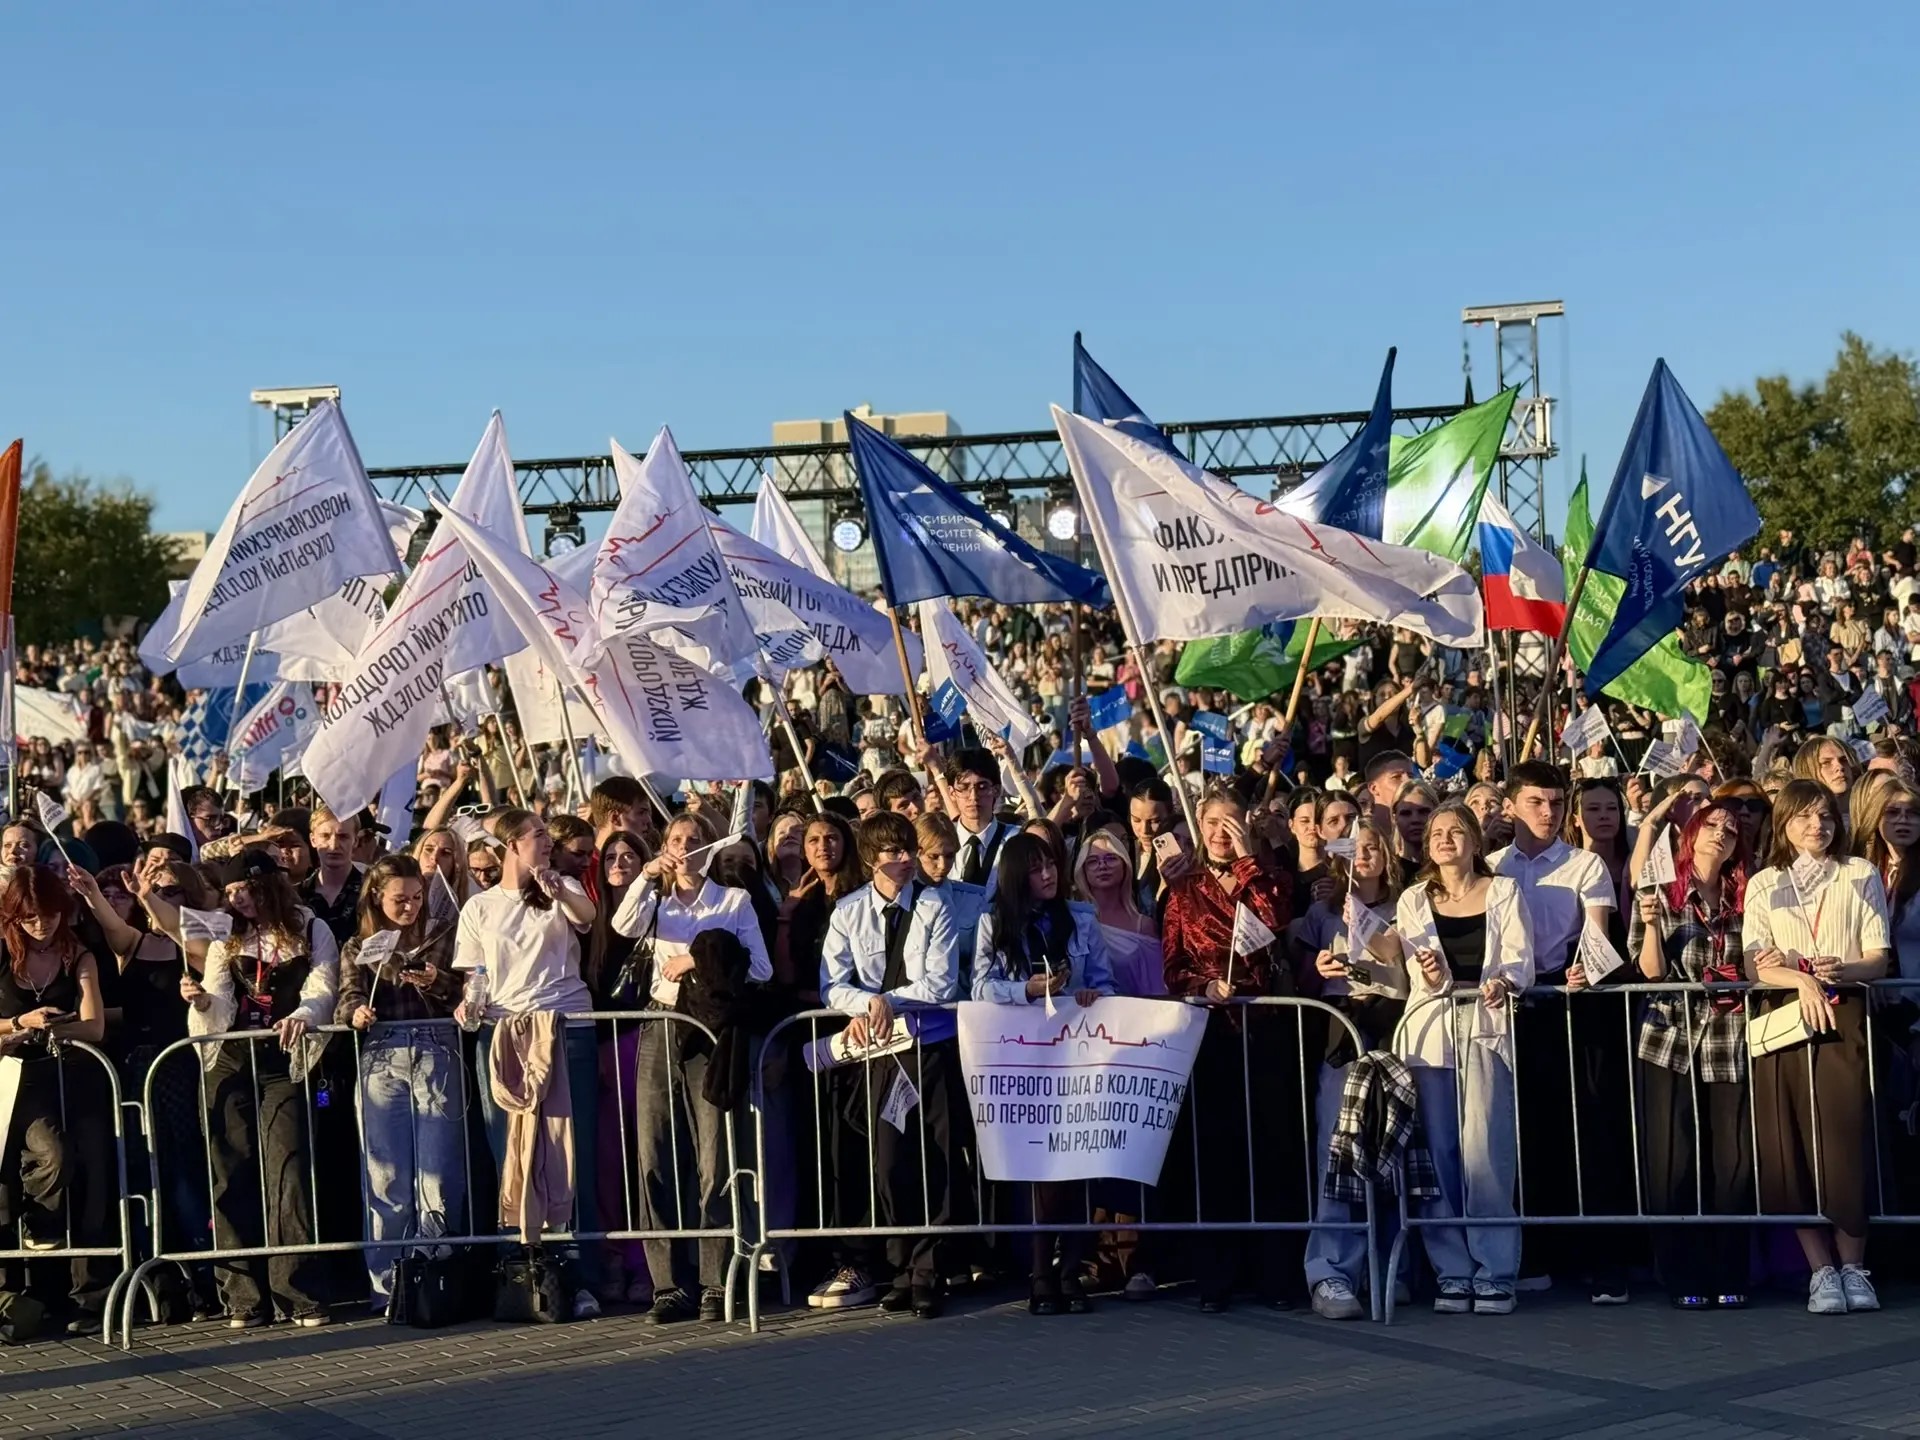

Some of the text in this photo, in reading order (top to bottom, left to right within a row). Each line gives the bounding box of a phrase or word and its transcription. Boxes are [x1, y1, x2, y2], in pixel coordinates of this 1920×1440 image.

[1655, 492, 1706, 572] НГУ
[1152, 562, 1171, 592] И
[971, 1075, 985, 1095] ОТ
[990, 1075, 1052, 1097] ПЕРВОГО
[1057, 1075, 1091, 1096] ШАГА
[1094, 1074, 1104, 1094] В
[977, 1103, 995, 1127] ДО
[1000, 1103, 1062, 1125] ПЕРВОГО
[1067, 1102, 1138, 1124] БОЛЬШОГО
[1048, 1132, 1071, 1152] МЫ
[1074, 1130, 1127, 1153] РЯДОМ!
